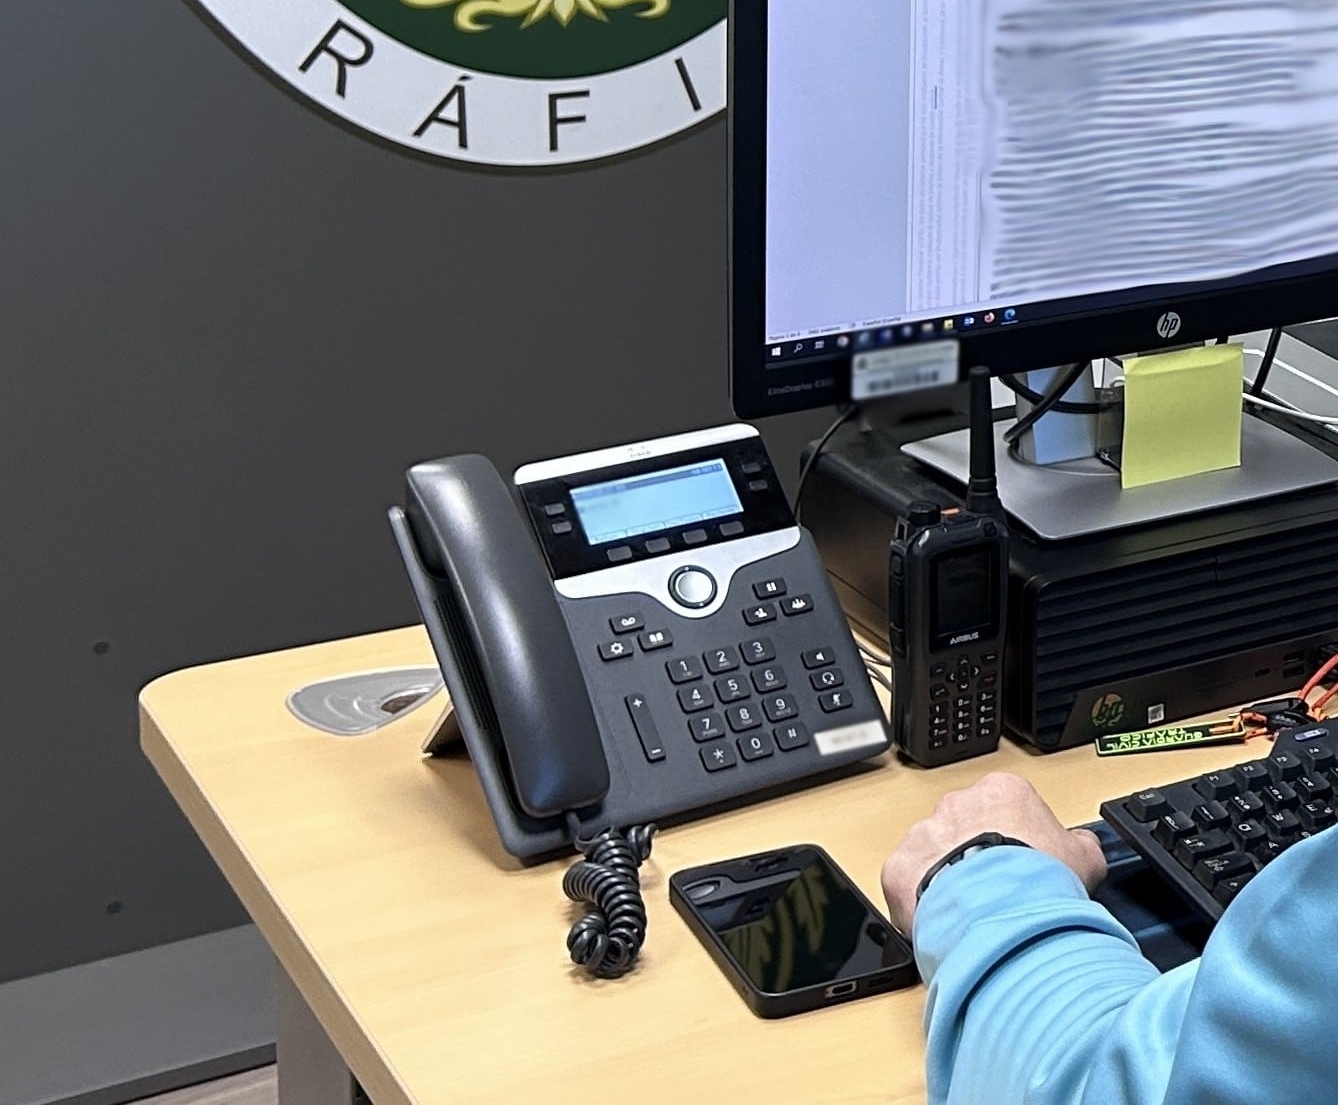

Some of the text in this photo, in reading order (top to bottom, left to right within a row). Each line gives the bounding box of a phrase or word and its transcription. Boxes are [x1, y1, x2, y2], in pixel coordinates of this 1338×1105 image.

[1157, 311, 1181, 338] hp
[949, 631, 980, 646] AIRBUS
[716, 650, 727, 663] 2
[752, 641, 763, 653] 3
[692, 669, 774, 700] 4 5 6
[701, 698, 786, 730] 7 8 9
[750, 737, 761, 750] 0
[1106, 731, 1203, 751] GUARDIA CIVIL
